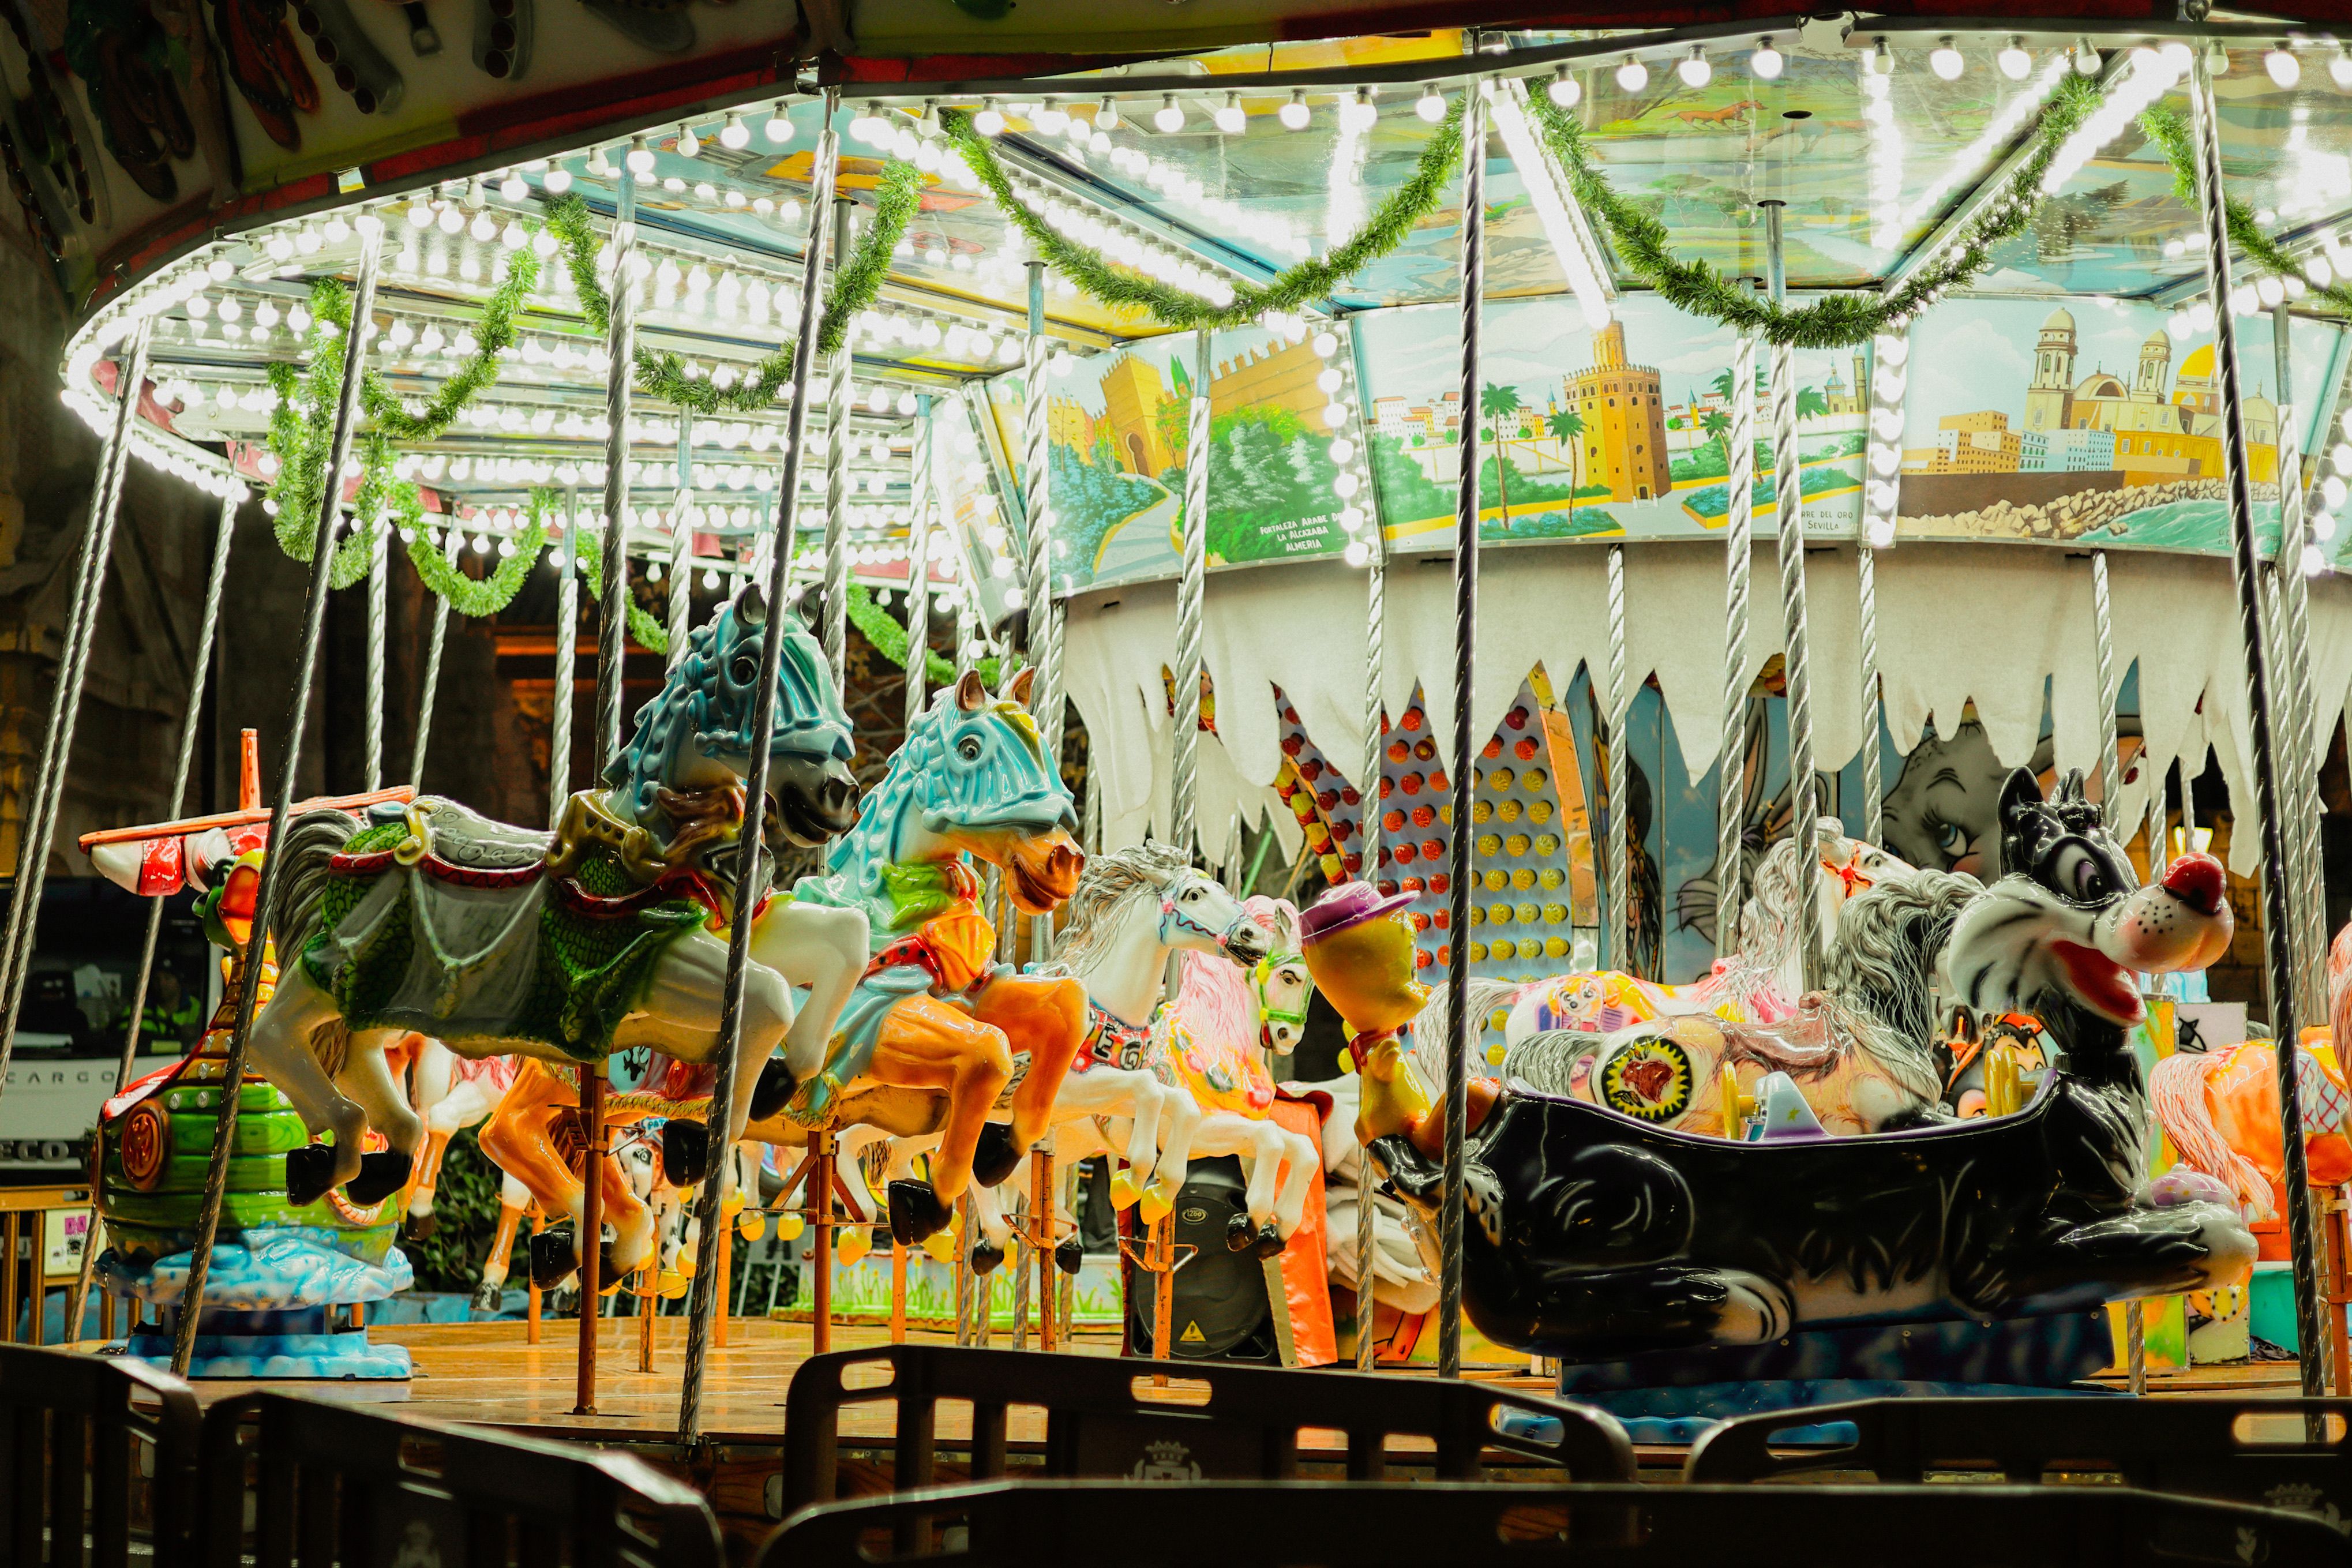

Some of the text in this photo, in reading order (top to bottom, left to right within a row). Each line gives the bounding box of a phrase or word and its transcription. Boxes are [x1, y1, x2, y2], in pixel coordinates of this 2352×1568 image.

[1837, 511, 1854, 519] ORO
[1259, 520, 1298, 535] FORTALEZA
[1301, 515, 1329, 527] ARABE
[1277, 526, 1329, 542] LA ALCAZABA
[1286, 539, 1323, 552] ALMERIA
[6, 1071, 115, 1083] CARGO
